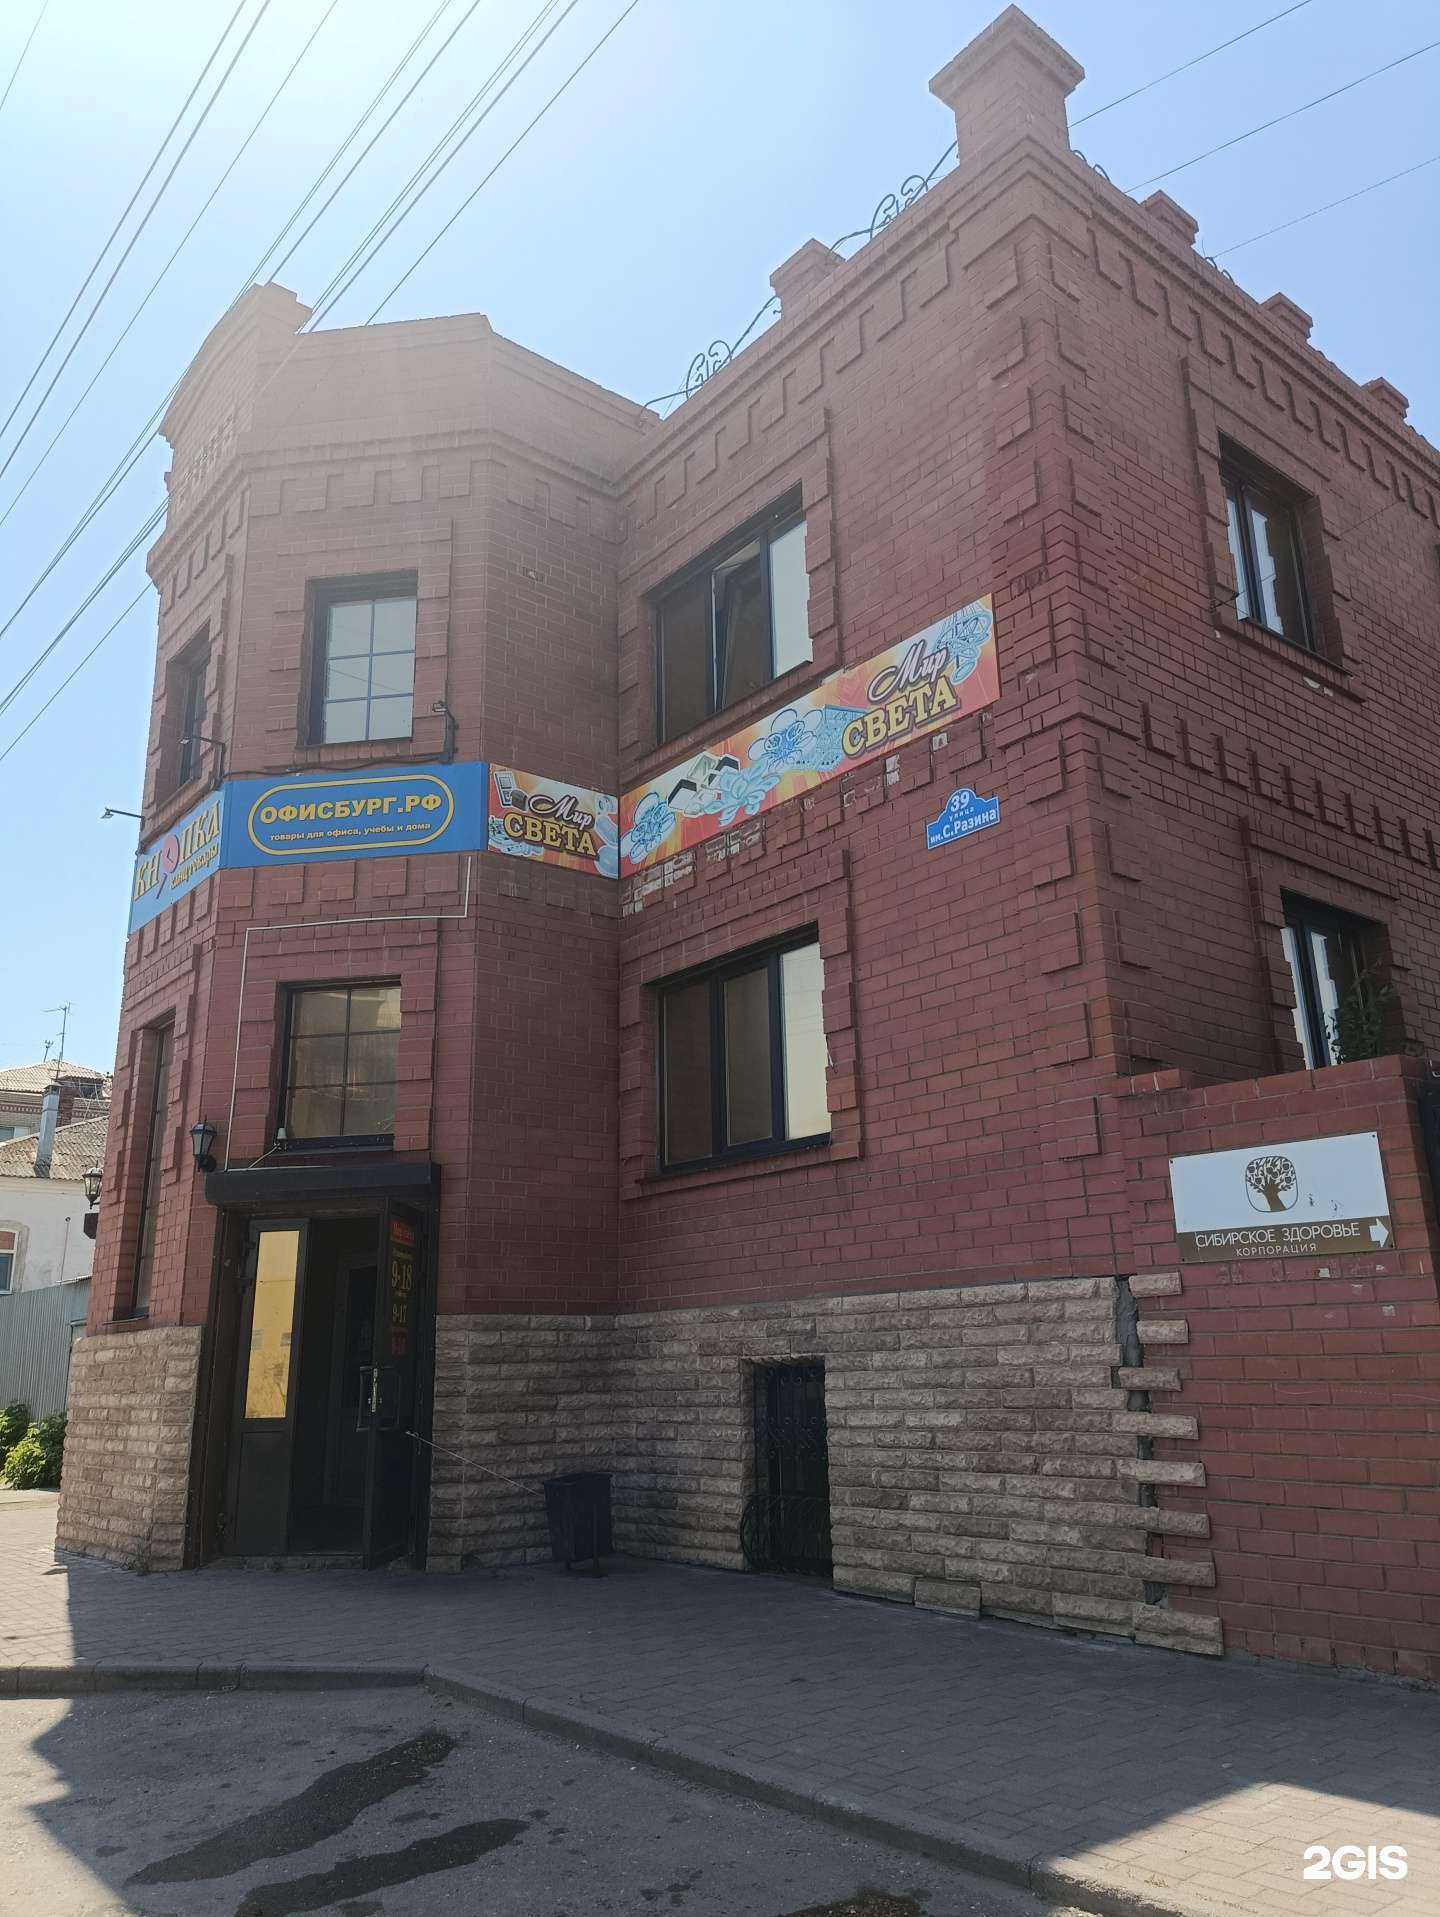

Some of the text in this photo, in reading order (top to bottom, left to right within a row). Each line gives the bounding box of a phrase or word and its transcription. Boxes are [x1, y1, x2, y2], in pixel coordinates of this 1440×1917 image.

[868, 639, 948, 701] Мир
[842, 675, 958, 757] СВЕТА
[260, 793, 442, 825] ОФИСБУРГ.РФ
[528, 795, 594, 830] Мир
[949, 807, 975, 822] улица
[950, 791, 970, 812] 39
[270, 831, 305, 843] товары
[306, 829, 324, 840] для
[326, 828, 362, 838] офиса,
[363, 825, 395, 836] учебы
[405, 822, 431, 832] дома
[503, 812, 597, 857] СВЕТА
[1195, 1221, 1361, 1249] СИБИРСКОЕ ЗДОРОВЬЕ
[1236, 1243, 1318, 1258] КОРПОРАЦИЯ
